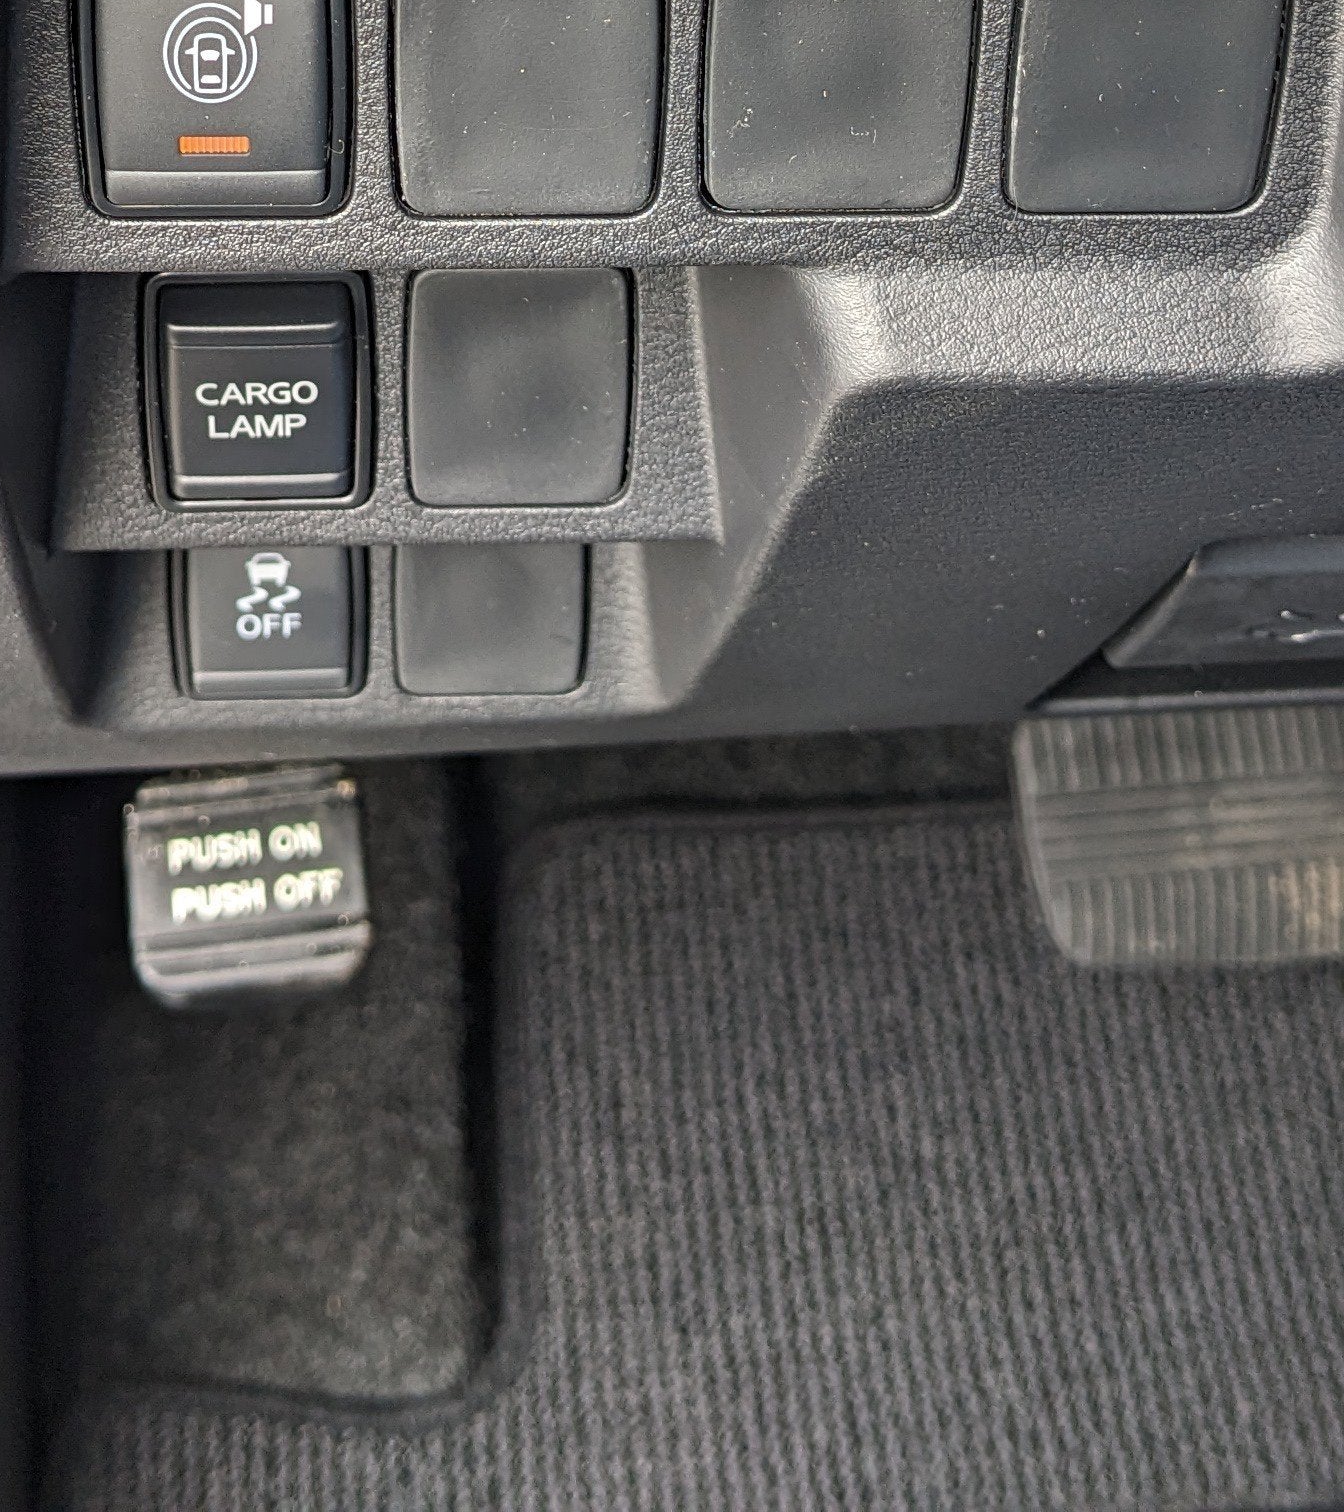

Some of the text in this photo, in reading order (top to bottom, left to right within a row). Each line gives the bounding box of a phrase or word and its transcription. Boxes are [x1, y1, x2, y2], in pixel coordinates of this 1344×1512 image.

[195, 380, 319, 407] CARGO
[207, 413, 307, 439] LAMP
[236, 612, 303, 640] OFF
[167, 821, 323, 875] PUSH ON
[171, 867, 344, 924] PUSH OFF
